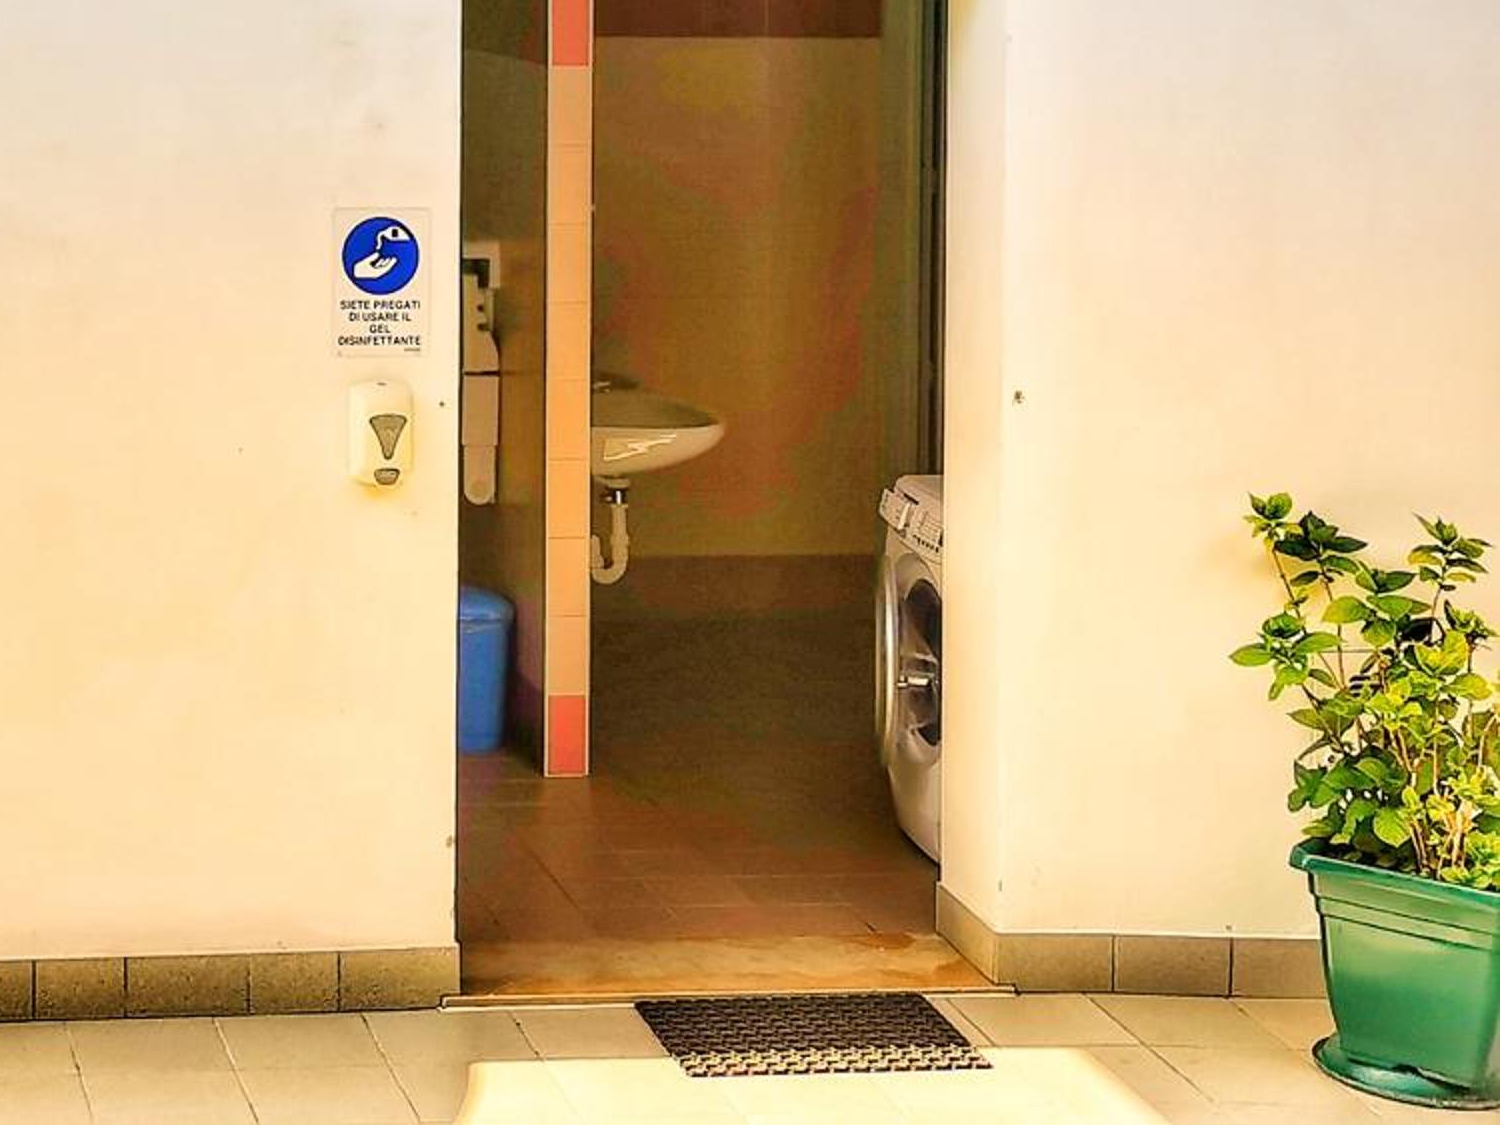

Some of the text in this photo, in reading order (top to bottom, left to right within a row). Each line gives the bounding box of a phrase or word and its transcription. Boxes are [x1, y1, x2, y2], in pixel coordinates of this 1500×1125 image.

[340, 300, 420, 310] SIETE PREGATI
[349, 312, 411, 321] DI USARE IL
[369, 324, 390, 333] GEL
[338, 336, 420, 346] DISINFETTANTE
